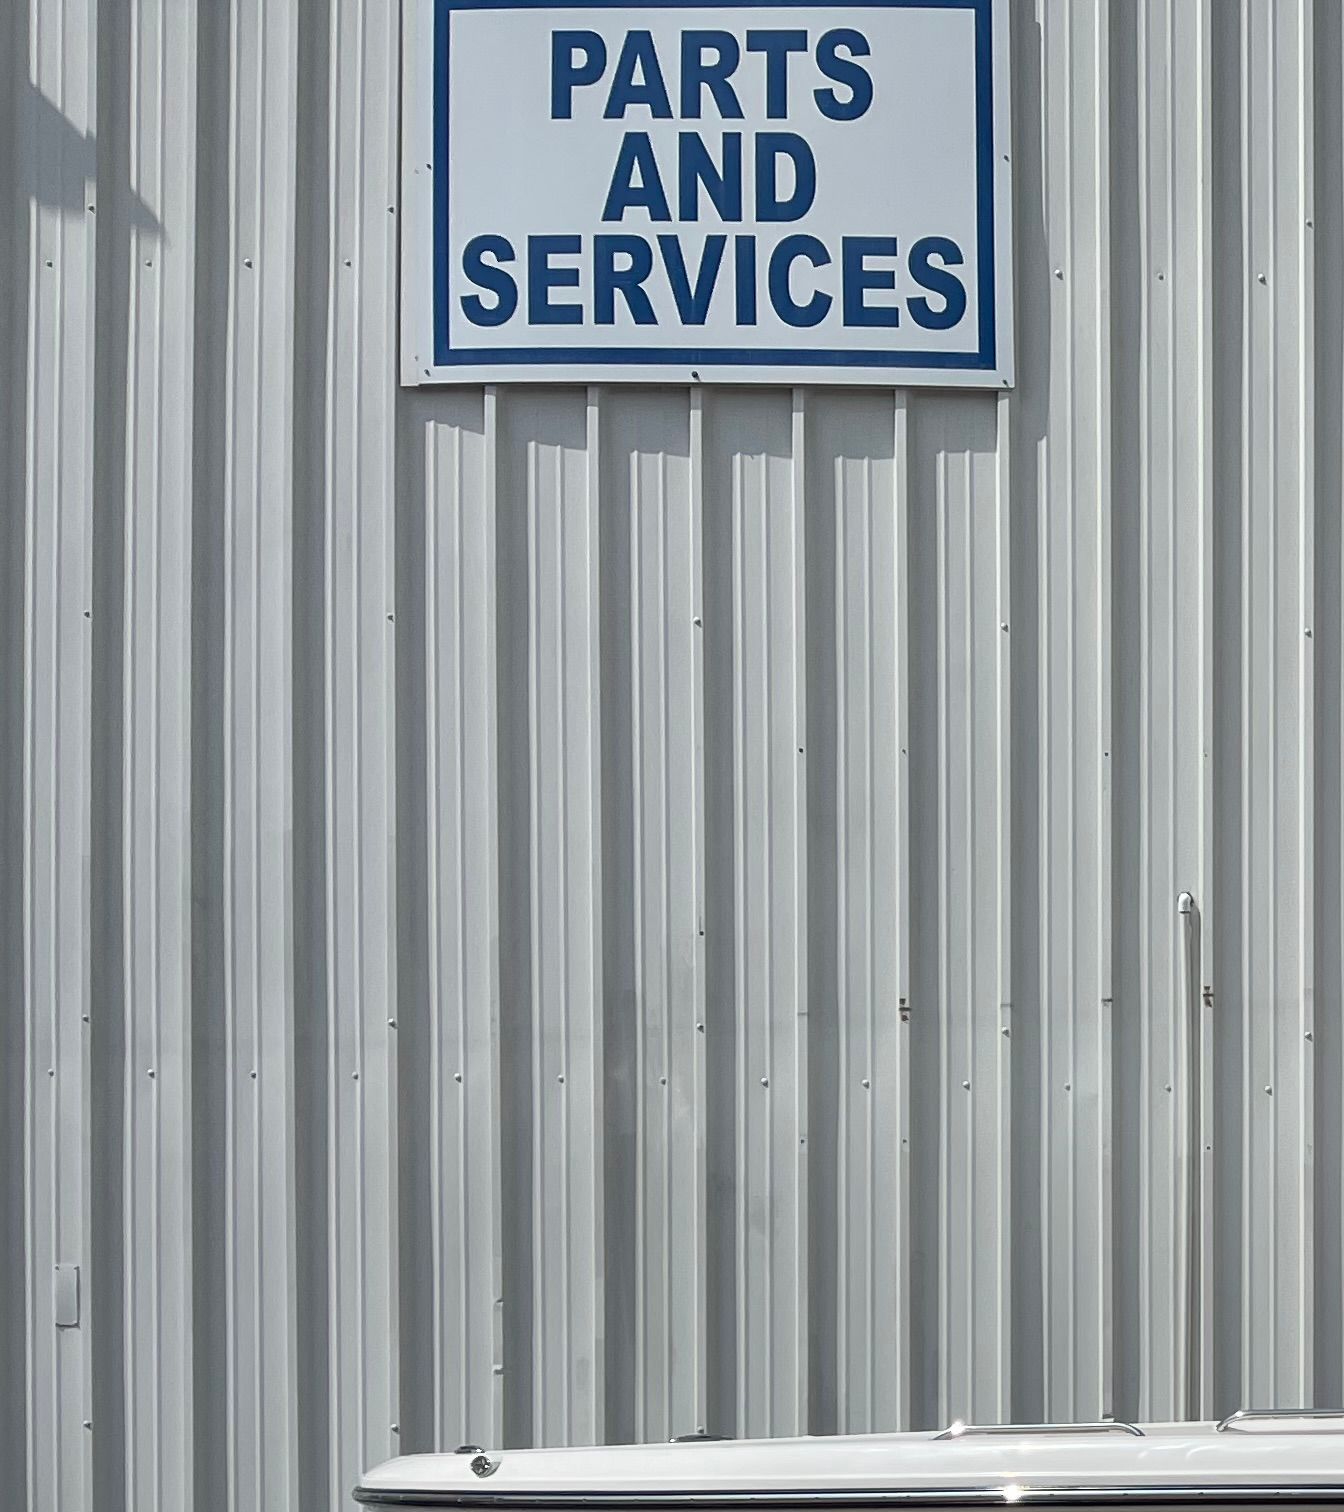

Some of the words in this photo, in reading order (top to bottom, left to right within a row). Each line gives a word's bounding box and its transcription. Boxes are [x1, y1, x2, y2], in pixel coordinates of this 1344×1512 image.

[550, 28, 874, 121] PARTS
[600, 131, 817, 222] AND
[459, 234, 967, 330] SERVICES
